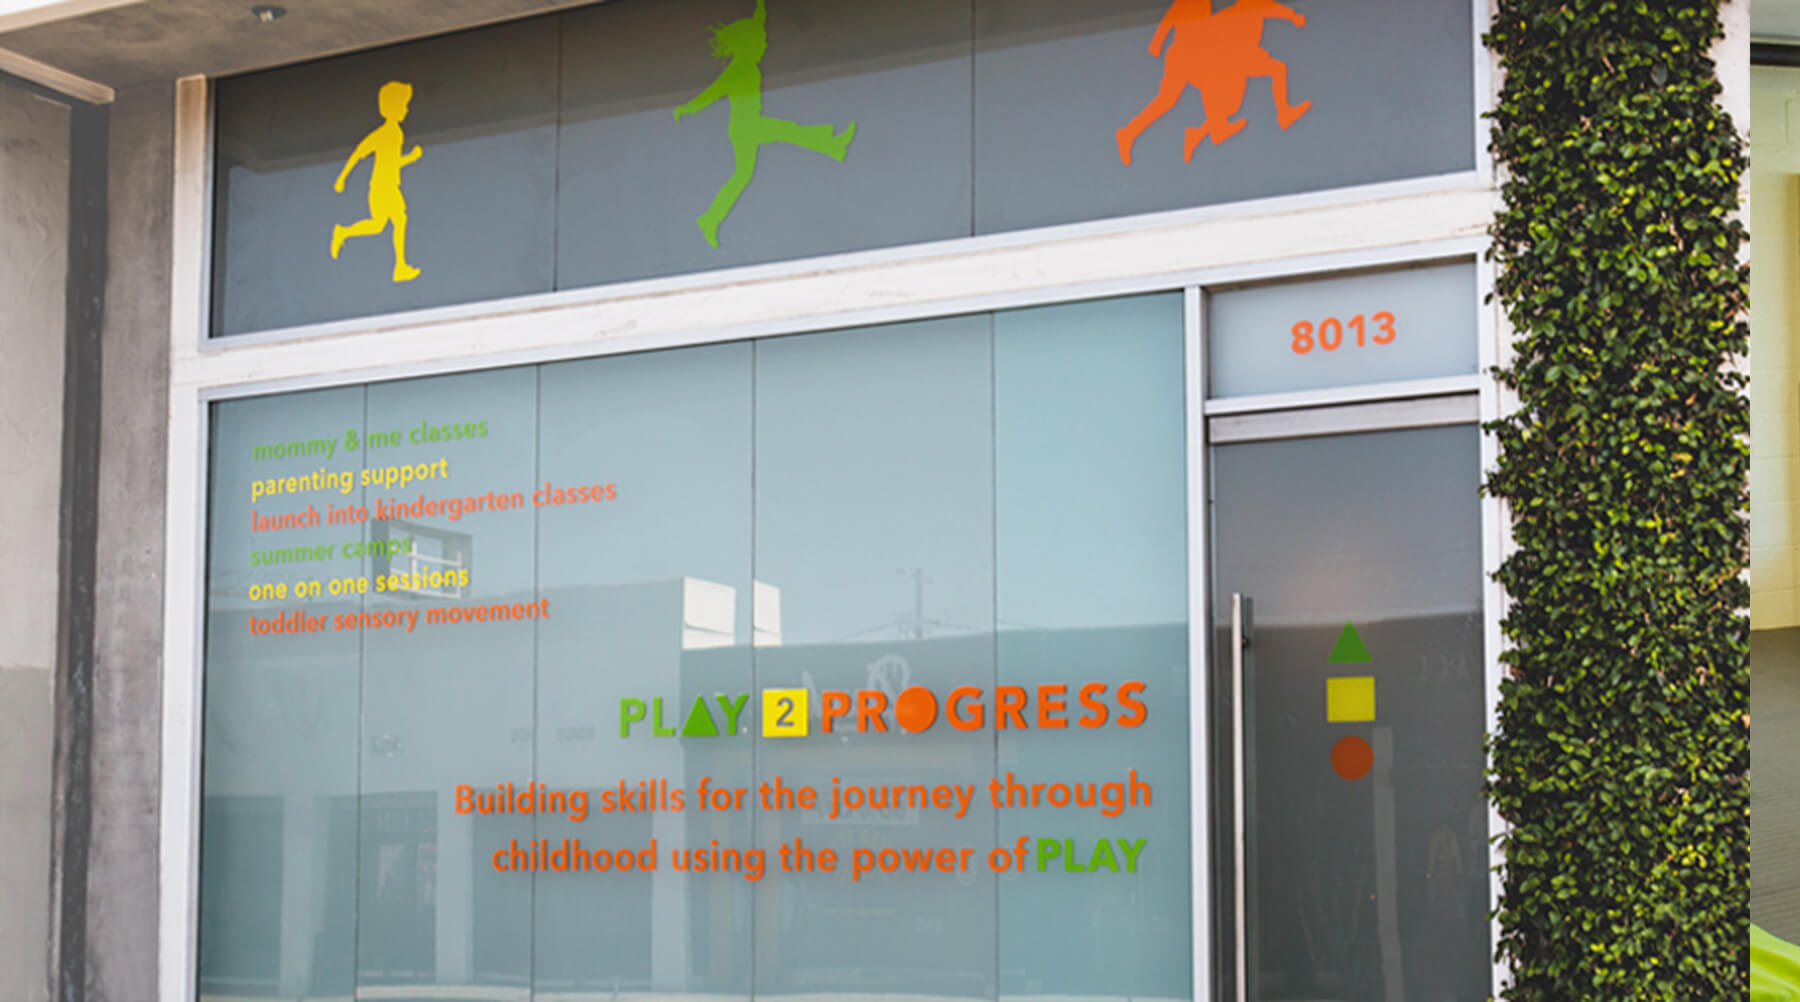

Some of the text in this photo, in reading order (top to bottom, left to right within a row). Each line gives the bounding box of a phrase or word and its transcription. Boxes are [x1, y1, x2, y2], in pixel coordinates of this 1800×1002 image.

[1291, 310, 1396, 355] 8013
[252, 419, 489, 462] mommy & me classes
[251, 458, 449, 503] parenting support
[251, 482, 617, 533] launch into kindergarten classes
[251, 534, 412, 567] summer camps
[249, 567, 470, 601] one on one sessions
[249, 598, 549, 636] toddler sensory movement
[619, 681, 1149, 738] PLAY 2 PROGRESS
[455, 782, 588, 822] Building
[600, 779, 686, 814] skills
[697, 777, 748, 813] for
[759, 776, 818, 812] the
[828, 775, 975, 820] journey
[988, 770, 1153, 818] through
[492, 836, 1148, 883] childhood using the power of PLAY
